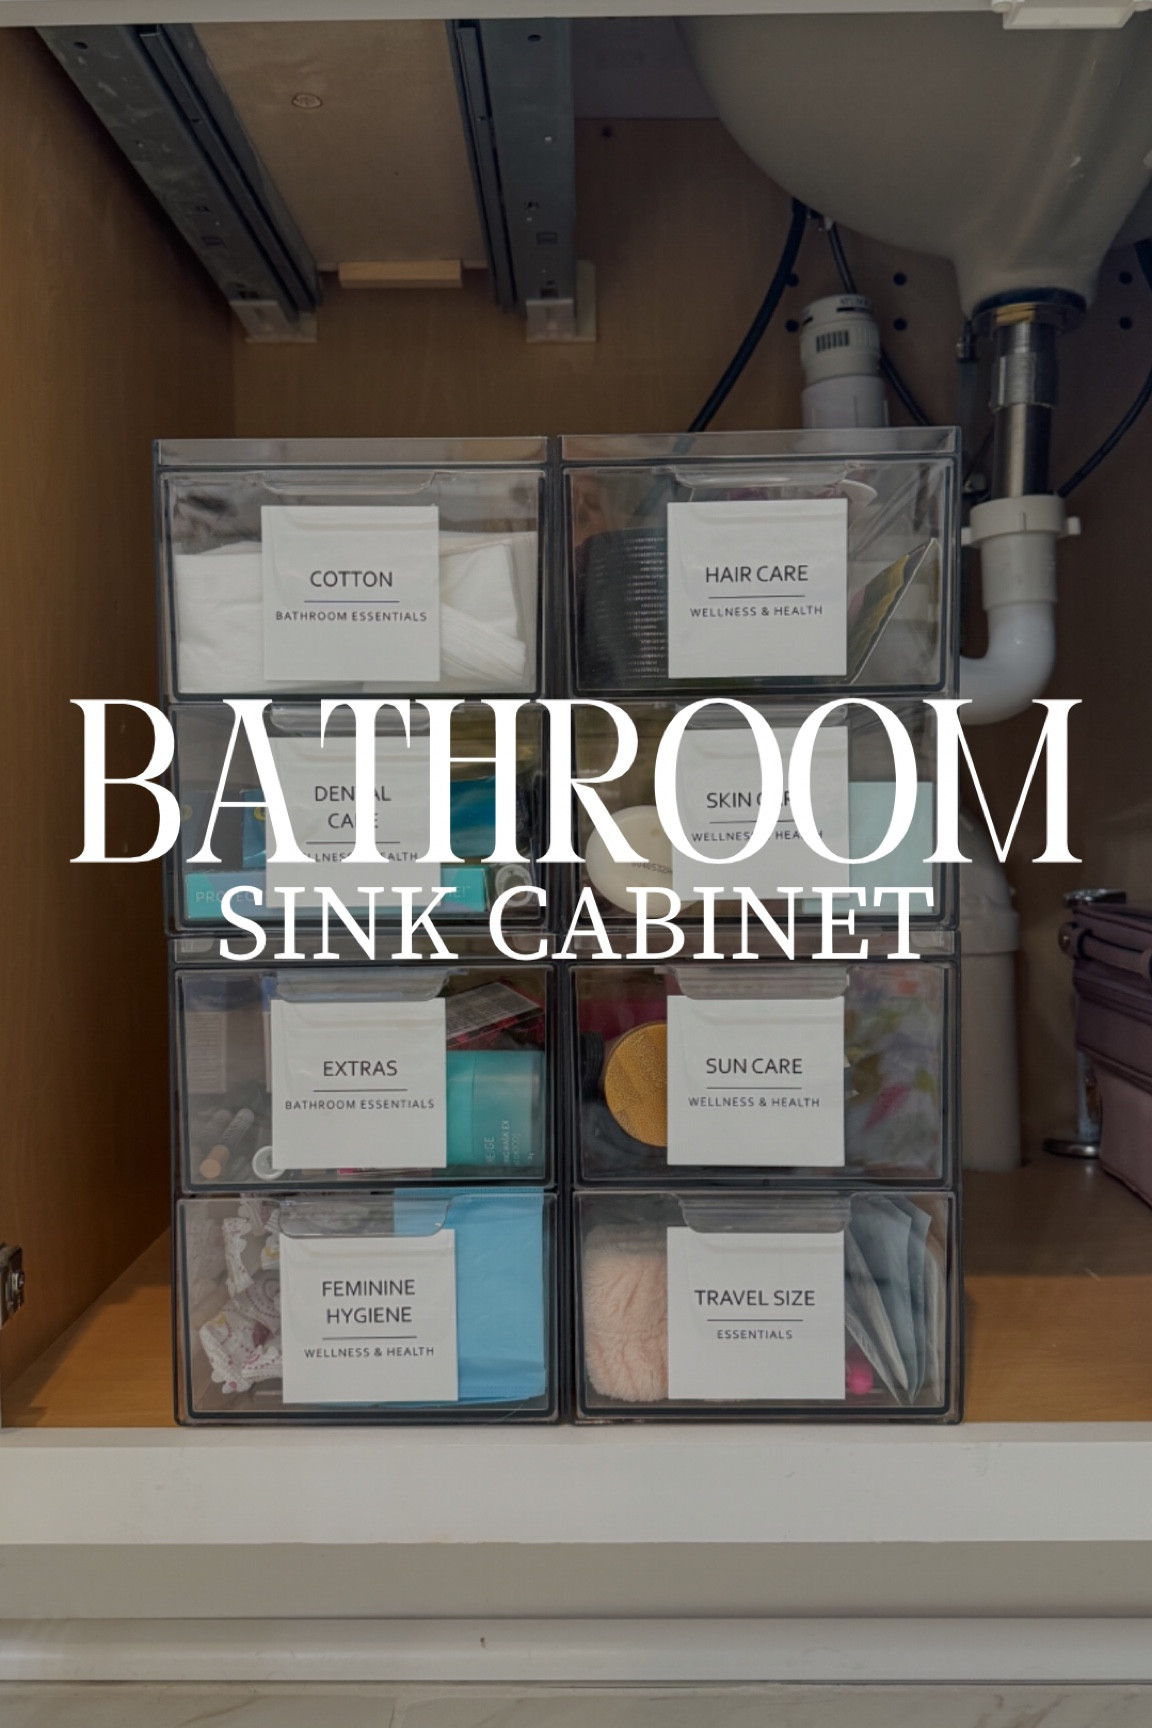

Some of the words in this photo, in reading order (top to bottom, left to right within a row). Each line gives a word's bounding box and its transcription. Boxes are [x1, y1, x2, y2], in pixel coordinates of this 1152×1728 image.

[309, 569, 393, 588] COTTON
[705, 565, 752, 584] HAIR
[756, 564, 809, 583] CARE
[275, 610, 348, 622] BATHROOM
[351, 610, 428, 622] ESSENTIALS
[689, 606, 757, 618] WELLNESS
[760, 606, 770, 617] &
[773, 604, 823, 616] HEALTH
[706, 791, 752, 809] SKIN
[323, 1059, 398, 1077] EXTRAS
[705, 1057, 748, 1075] SUN
[751, 1057, 803, 1075] CARE
[284, 1099, 356, 1110] BATHROOM
[359, 1098, 435, 1109] ESSENTIALS
[688, 1096, 755, 1108] WELLNESS
[758, 1096, 767, 1107] &
[771, 1097, 820, 1108] HEALTH
[321, 1278, 416, 1298] FEMININE
[694, 1289, 770, 1306] TRAVEL
[773, 1289, 816, 1306] SIZE
[326, 1305, 413, 1325] HYGIENE
[716, 1329, 793, 1340] ESSENTIALS
[303, 1347, 370, 1359] WELLNESS
[373, 1347, 383, 1358] &
[386, 1346, 434, 1357] HEALTH
